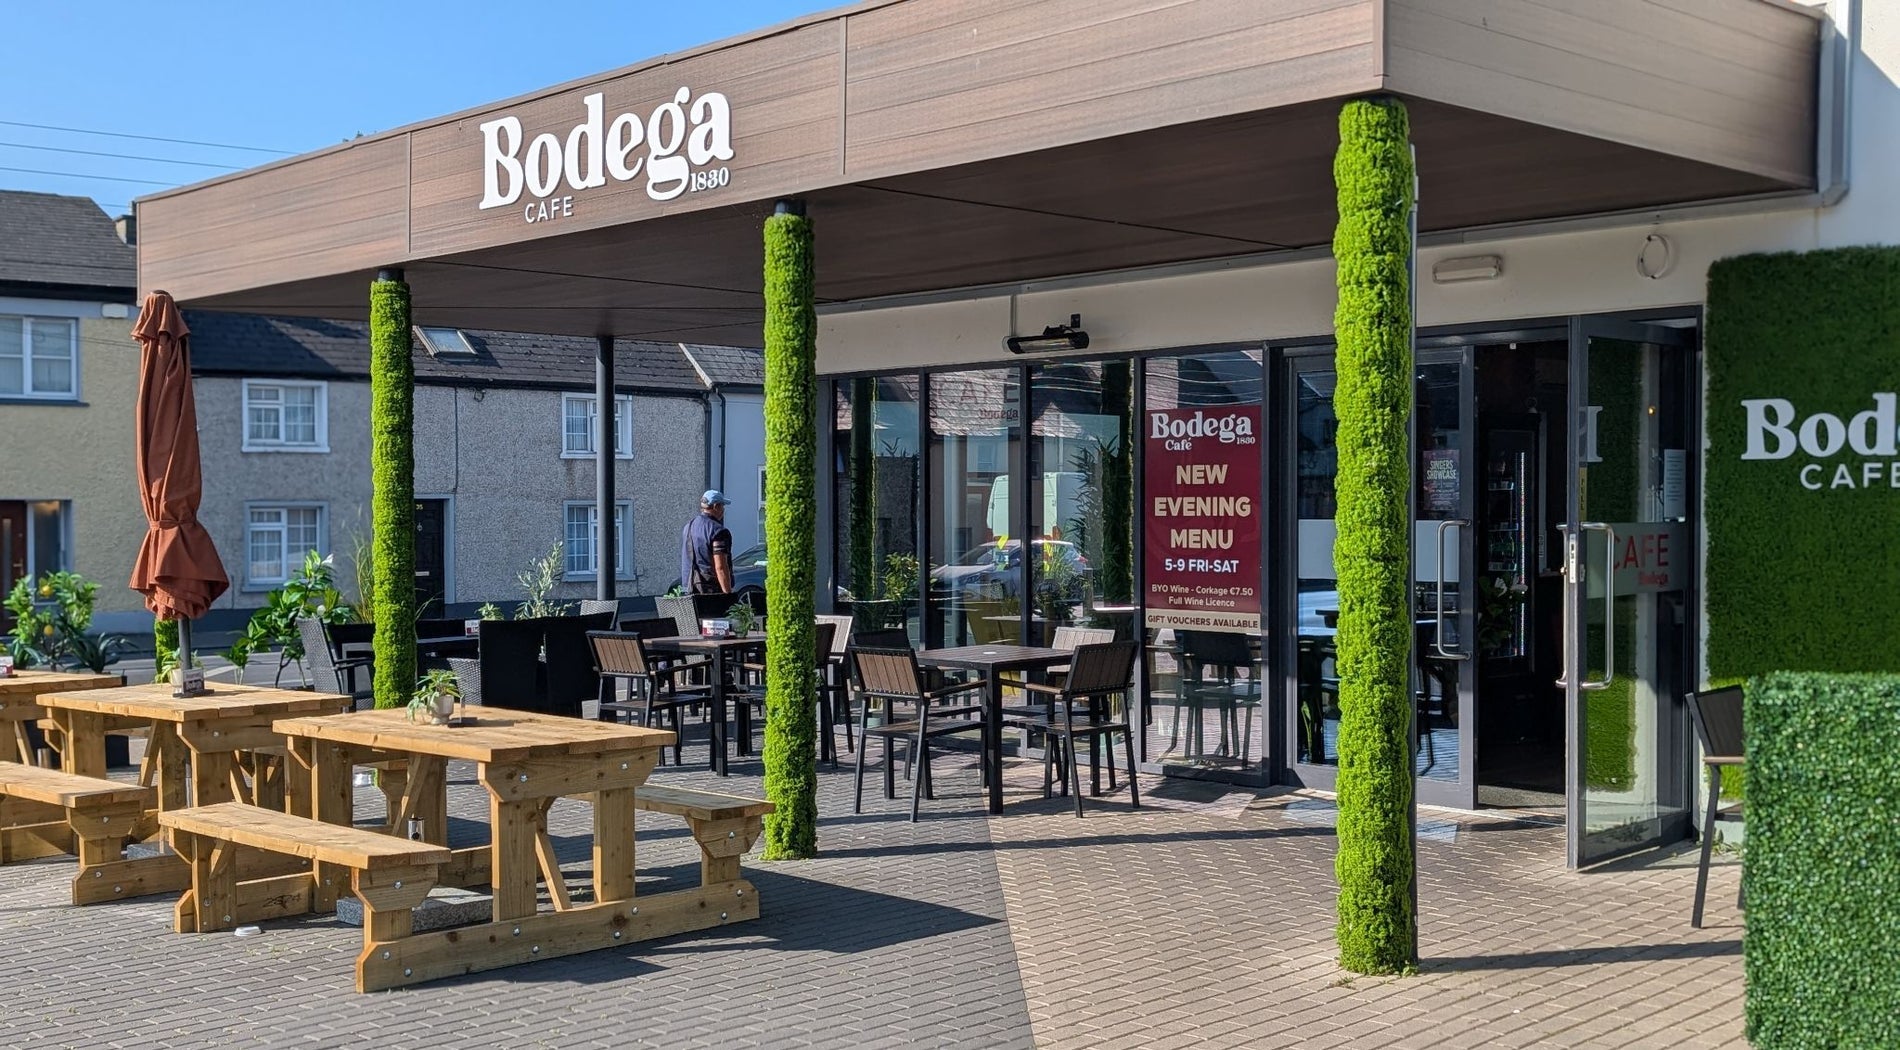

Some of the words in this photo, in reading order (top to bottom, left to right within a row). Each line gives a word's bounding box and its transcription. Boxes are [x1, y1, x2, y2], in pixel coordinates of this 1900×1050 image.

[479, 86, 734, 210] Bodega
[690, 166, 730, 193] 1830
[524, 195, 573, 224] CAFE
[1150, 411, 1253, 443] Bodega
[1740, 392, 1900, 460] Bod
[1164, 437, 1193, 451] Café
[1236, 436, 1256, 445] 1830
[1430, 460, 1454, 470] SINGERS
[1176, 464, 1228, 485] NEW
[1426, 469, 1457, 480] SHOWCASE
[1154, 496, 1251, 517] EVENING
[1170, 529, 1234, 549] MENU
[1165, 558, 1185, 572] 5-9
[1188, 559, 1239, 573] FRI-SAT
[1151, 584, 1168, 593] BYO
[1170, 585, 1189, 593] Wine
[1196, 586, 1228, 596] Corkage
[1229, 587, 1253, 596] €7.50
[1168, 596, 1182, 604] Full
[1184, 597, 1204, 605] Wine
[1205, 598, 1235, 607] Licence
[1147, 615, 1165, 624] GIFT
[1167, 616, 1211, 626] VOUCHERS
[1213, 619, 1258, 628] AVAILABLE
